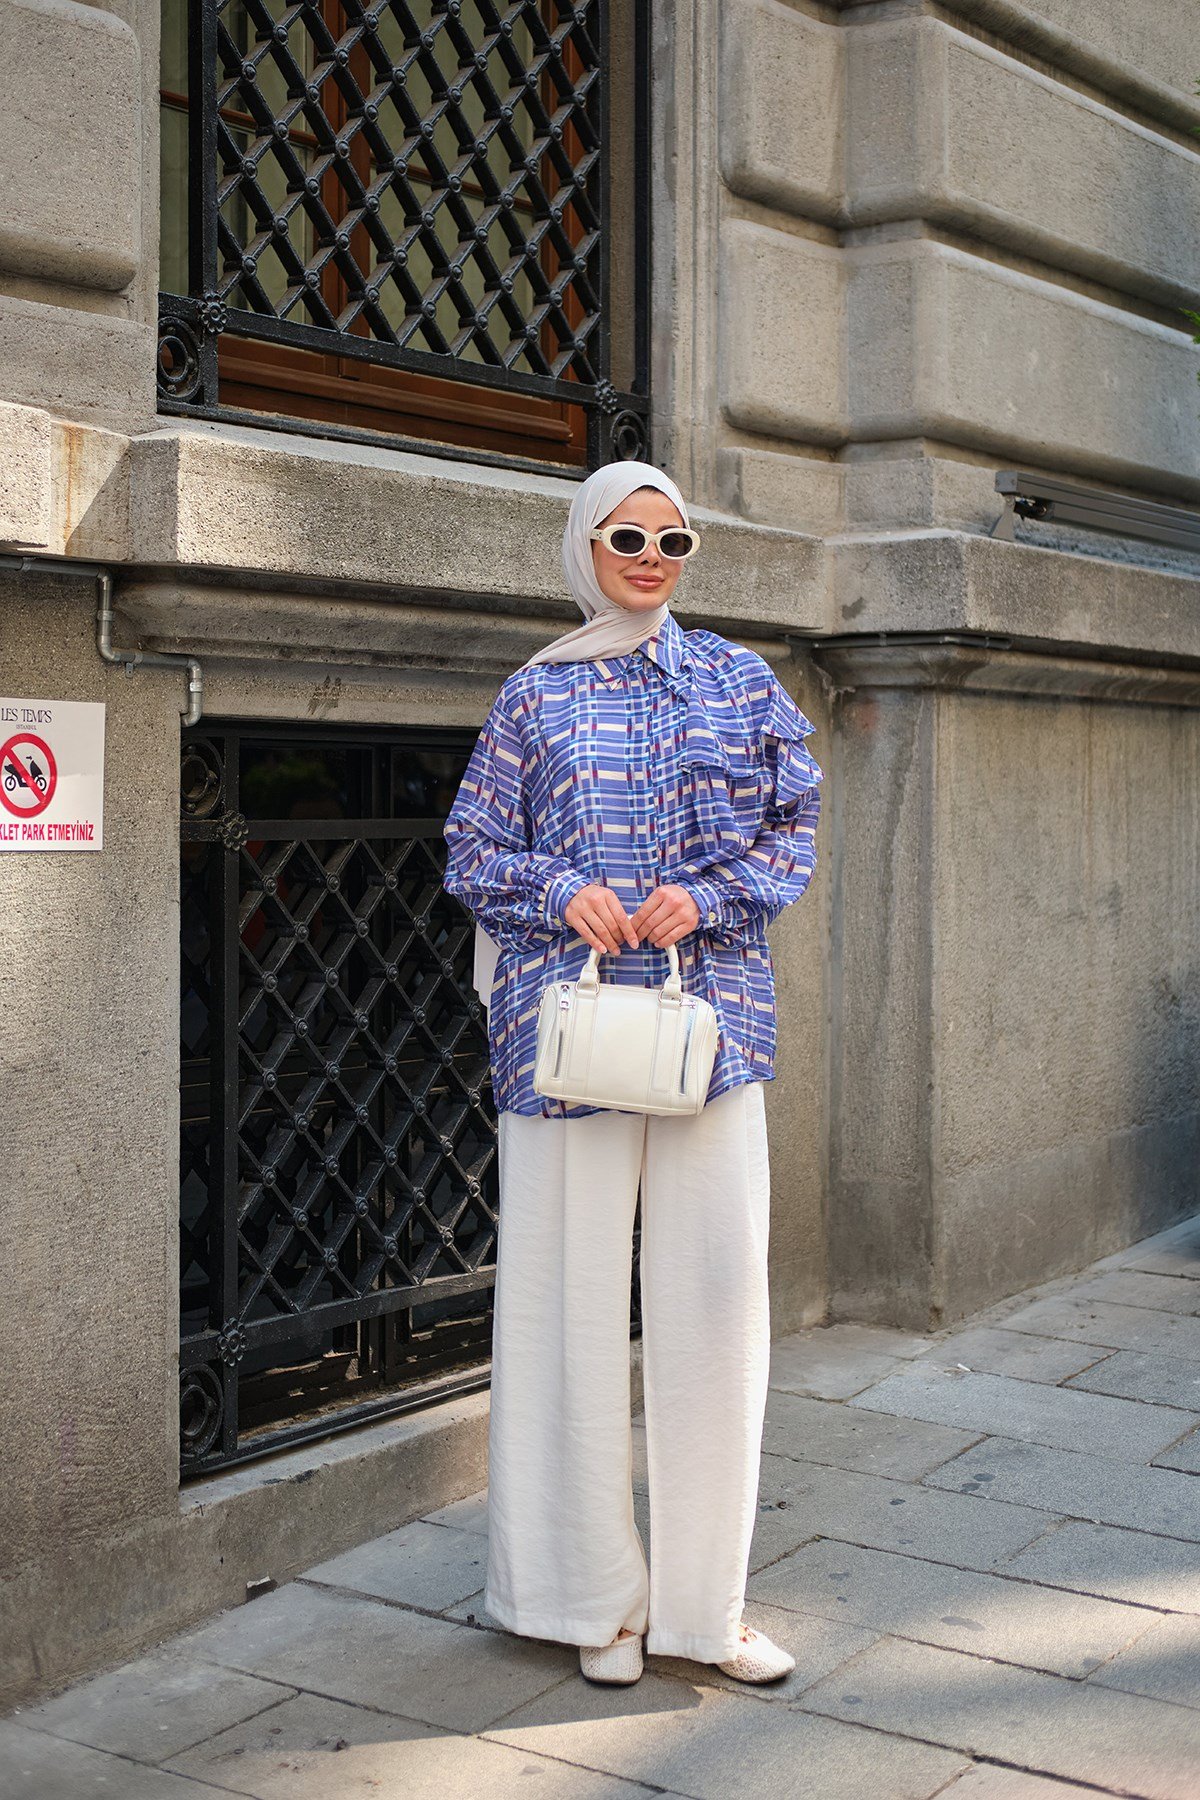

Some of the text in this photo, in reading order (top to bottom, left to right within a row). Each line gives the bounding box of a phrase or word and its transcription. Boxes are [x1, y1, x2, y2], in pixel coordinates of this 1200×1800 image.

[1, 708, 52, 723] LES TEMPS
[22, 824, 45, 840] PARK
[47, 820, 94, 840] ETMEYİNİZ
